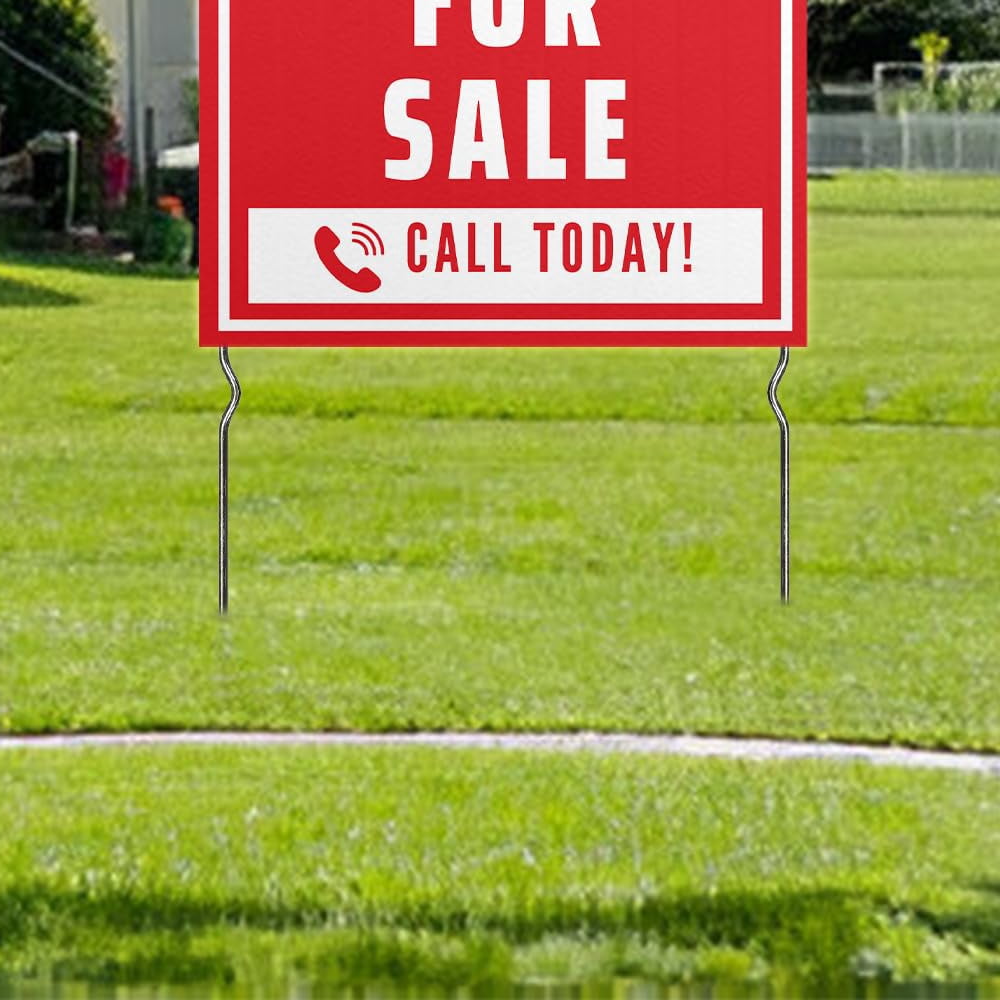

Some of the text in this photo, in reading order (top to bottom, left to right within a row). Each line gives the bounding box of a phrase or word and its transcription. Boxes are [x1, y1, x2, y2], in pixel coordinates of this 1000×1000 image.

[383, 78, 626, 181] SALE
[407, 222, 692, 273] CALL TODAY!
